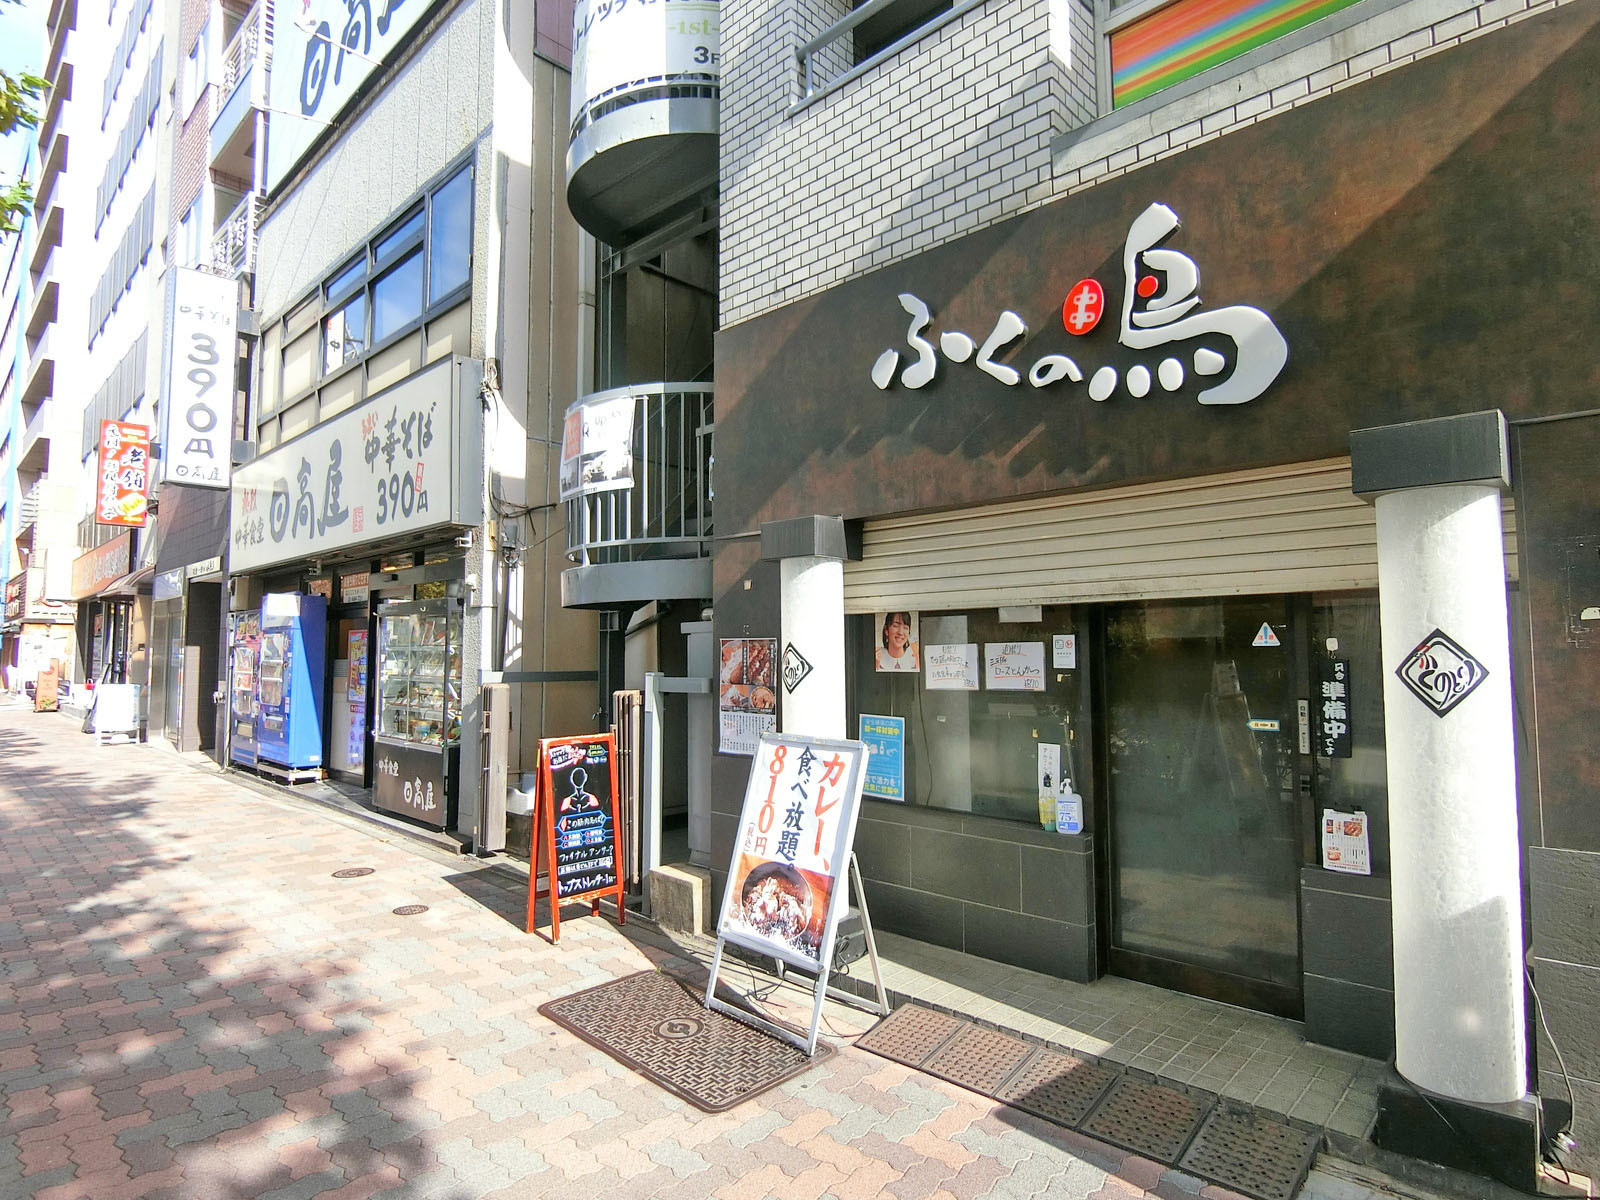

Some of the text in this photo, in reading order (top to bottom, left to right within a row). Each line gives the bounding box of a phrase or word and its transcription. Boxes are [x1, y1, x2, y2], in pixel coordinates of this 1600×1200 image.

[300, 0, 405, 117] 日高
[364, 401, 437, 474] 中華そば
[235, 516, 265, 550] 中華食堂
[269, 438, 349, 543] 日高屋
[377, 470, 429, 525] 390円
[1321, 662, 1347, 755] 只今準備中です
[403, 776, 437, 812] 日高屋
[753, 744, 788, 856] 810円
[775, 746, 817, 871] 食べ放題。
[814, 752, 846, 871] カレー、
